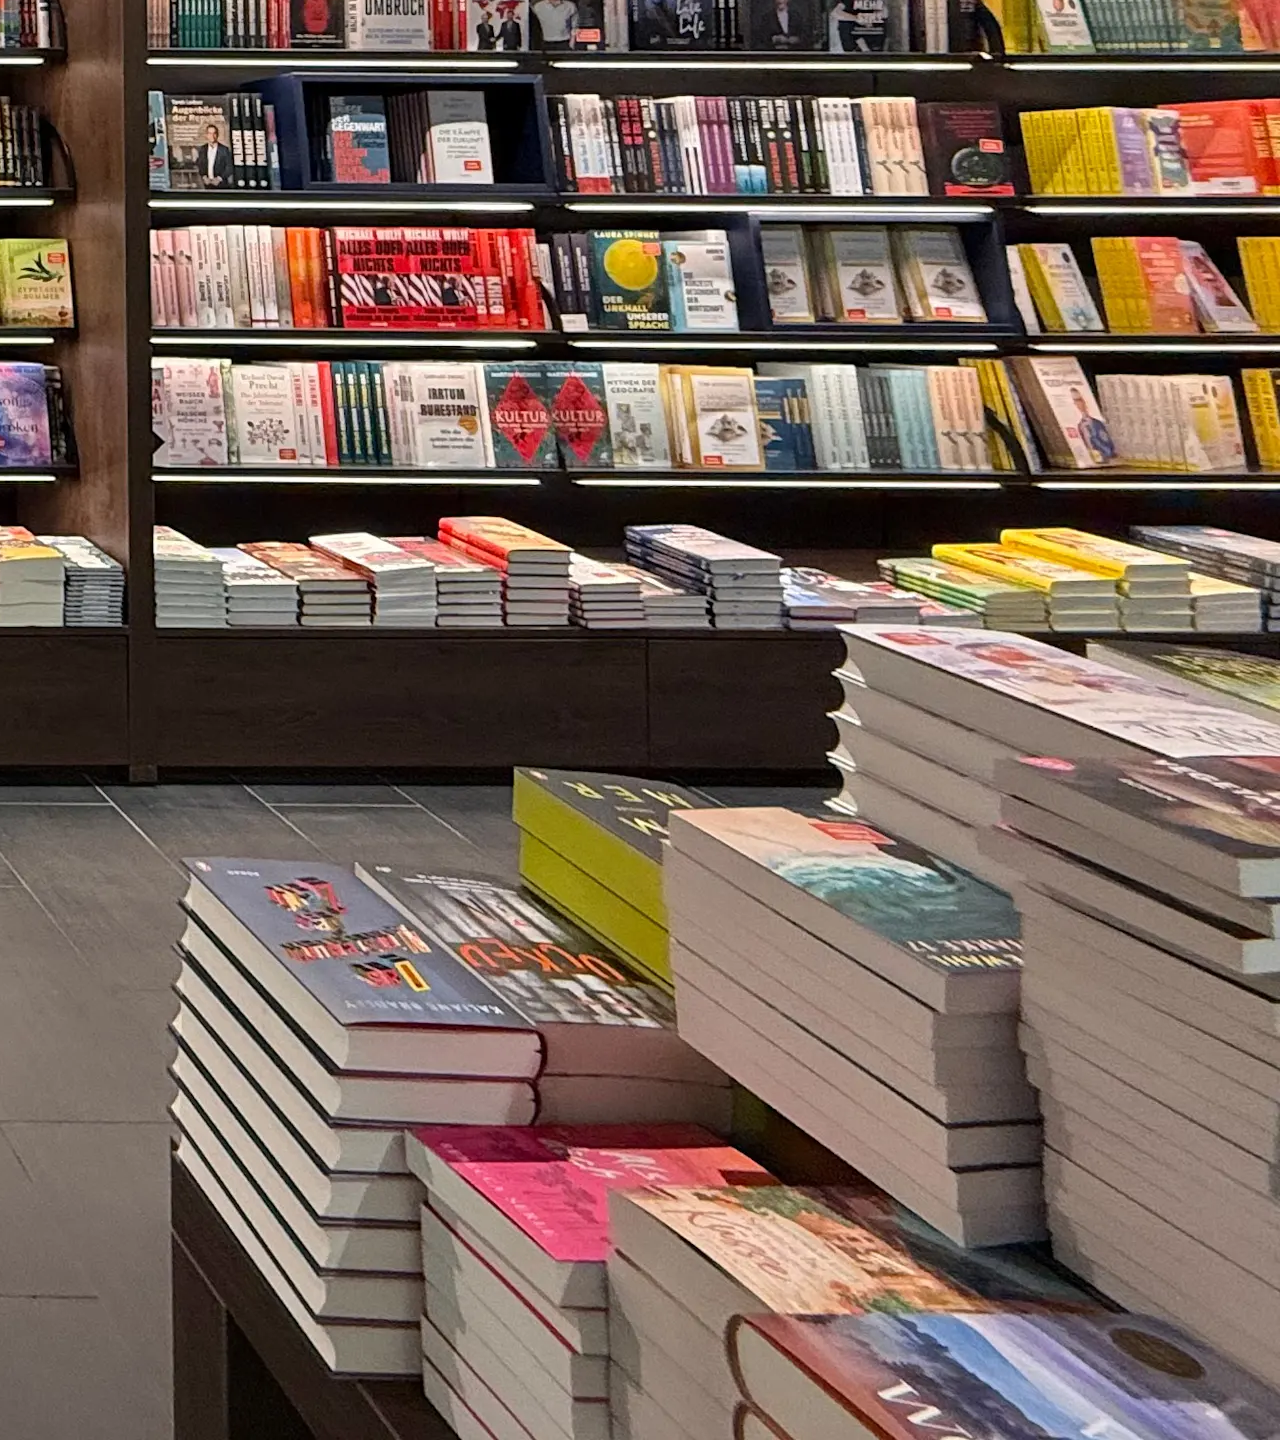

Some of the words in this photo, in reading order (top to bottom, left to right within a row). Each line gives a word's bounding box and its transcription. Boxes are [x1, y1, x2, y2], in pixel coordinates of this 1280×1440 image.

[331, 121, 386, 132] GEGENWART
[340, 240, 371, 256] ALLES
[406, 240, 438, 256] ALLES
[353, 257, 394, 272] NICHTS
[420, 257, 461, 272] NICHTS
[627, 313, 669, 321] UNSERER
[628, 320, 670, 330] SPRACHE
[420, 403, 477, 417] RUHESTAND
[494, 410, 547, 423] KULTUR
[552, 410, 605, 423] KULTUR
